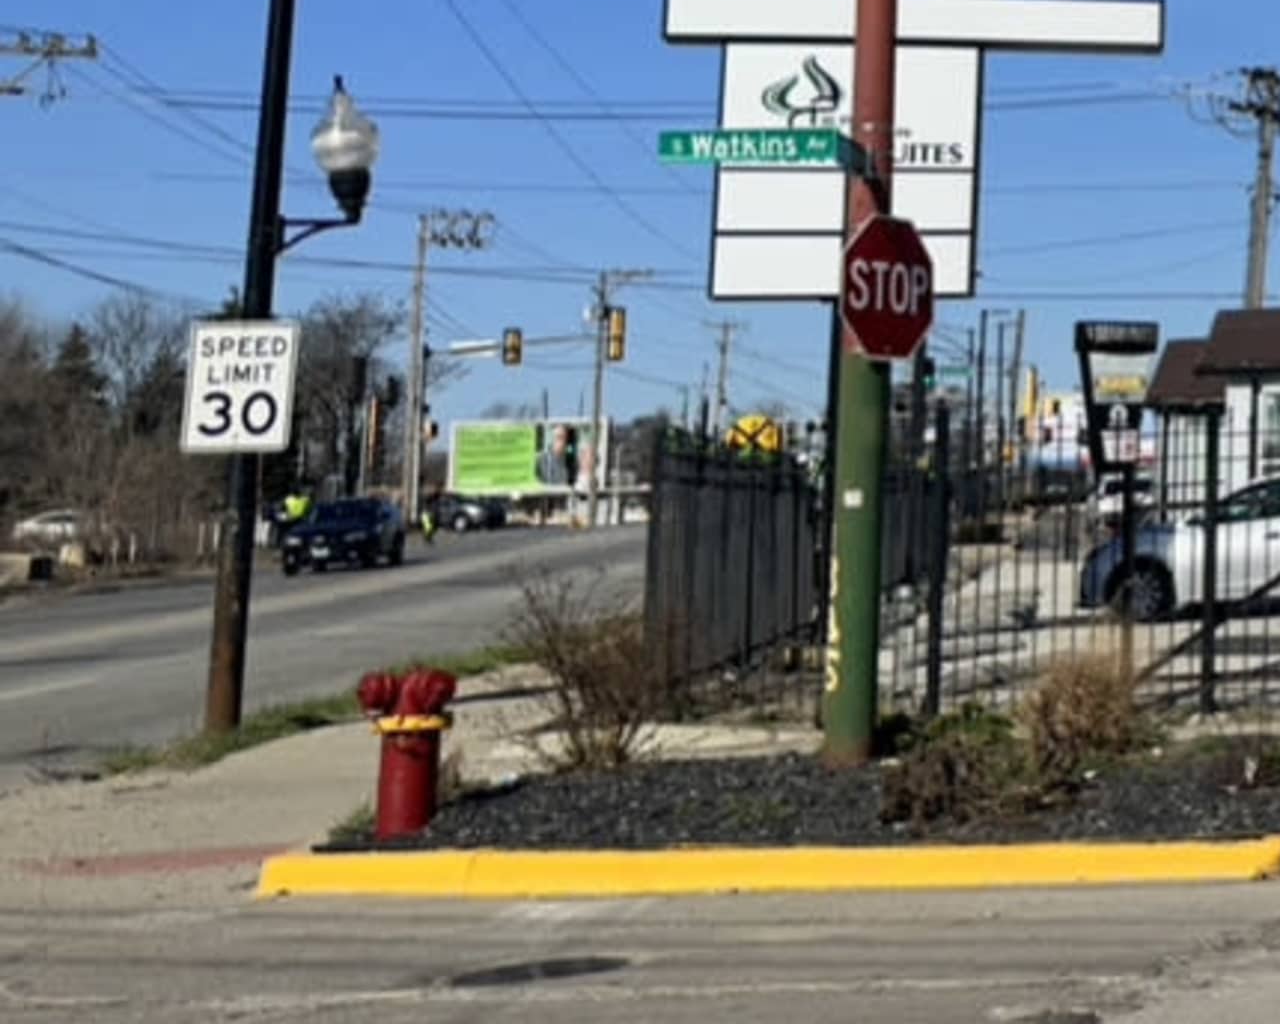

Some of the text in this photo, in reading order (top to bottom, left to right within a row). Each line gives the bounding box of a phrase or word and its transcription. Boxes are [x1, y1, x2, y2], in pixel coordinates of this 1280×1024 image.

[690, 131, 798, 159] Watkins
[895, 142, 964, 164] UITES
[848, 258, 928, 315] STOP
[201, 336, 288, 358] SPEED
[207, 362, 275, 385] LIMIT
[198, 391, 278, 438] 30
